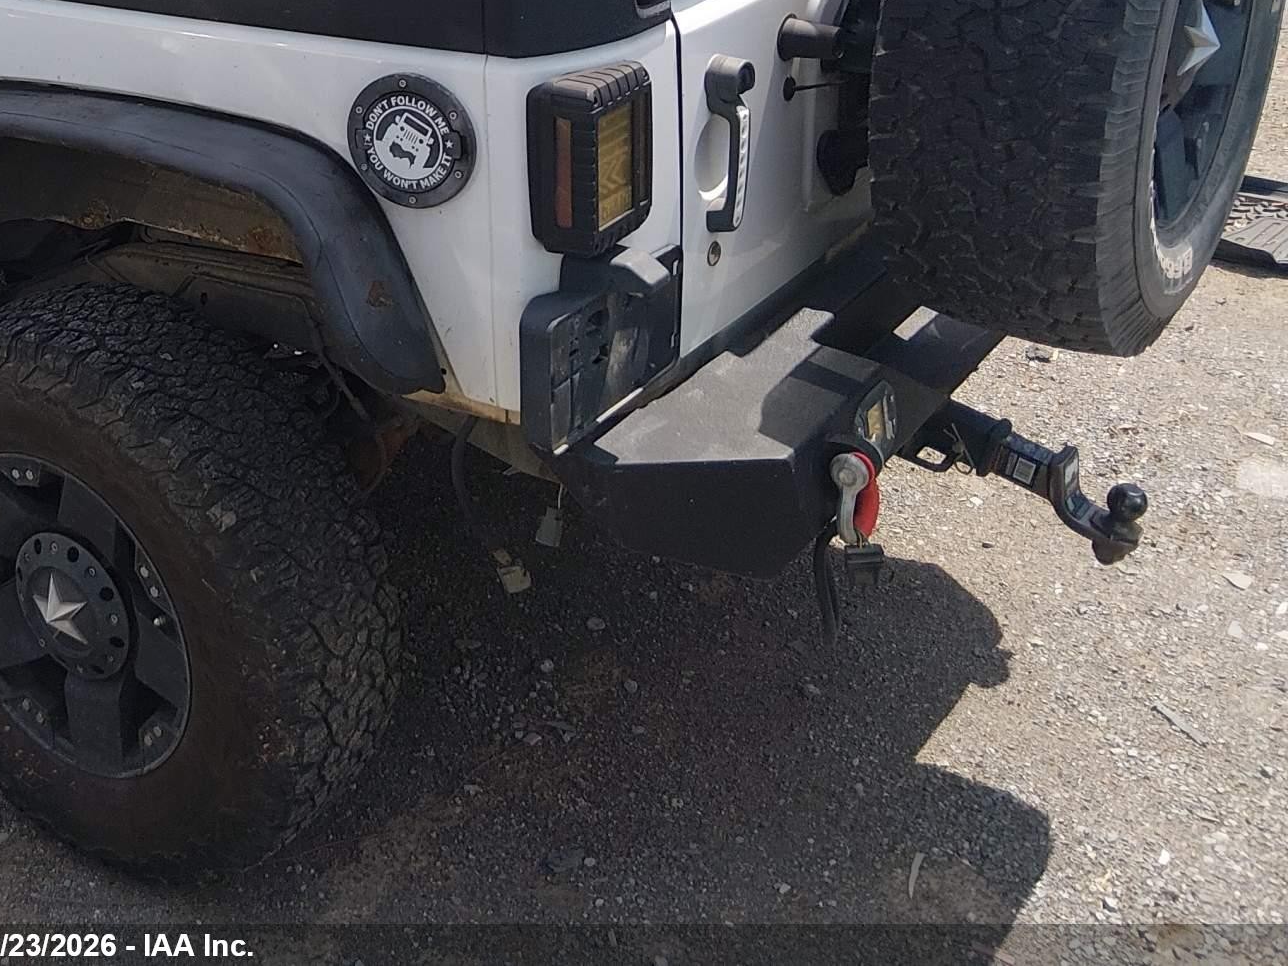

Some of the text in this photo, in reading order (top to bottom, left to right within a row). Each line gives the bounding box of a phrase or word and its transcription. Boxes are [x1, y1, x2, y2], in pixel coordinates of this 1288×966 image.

[365, 95, 450, 136] DON'T FOLLOW ME
[366, 146, 453, 190] YOU WON'T MAKE IT
